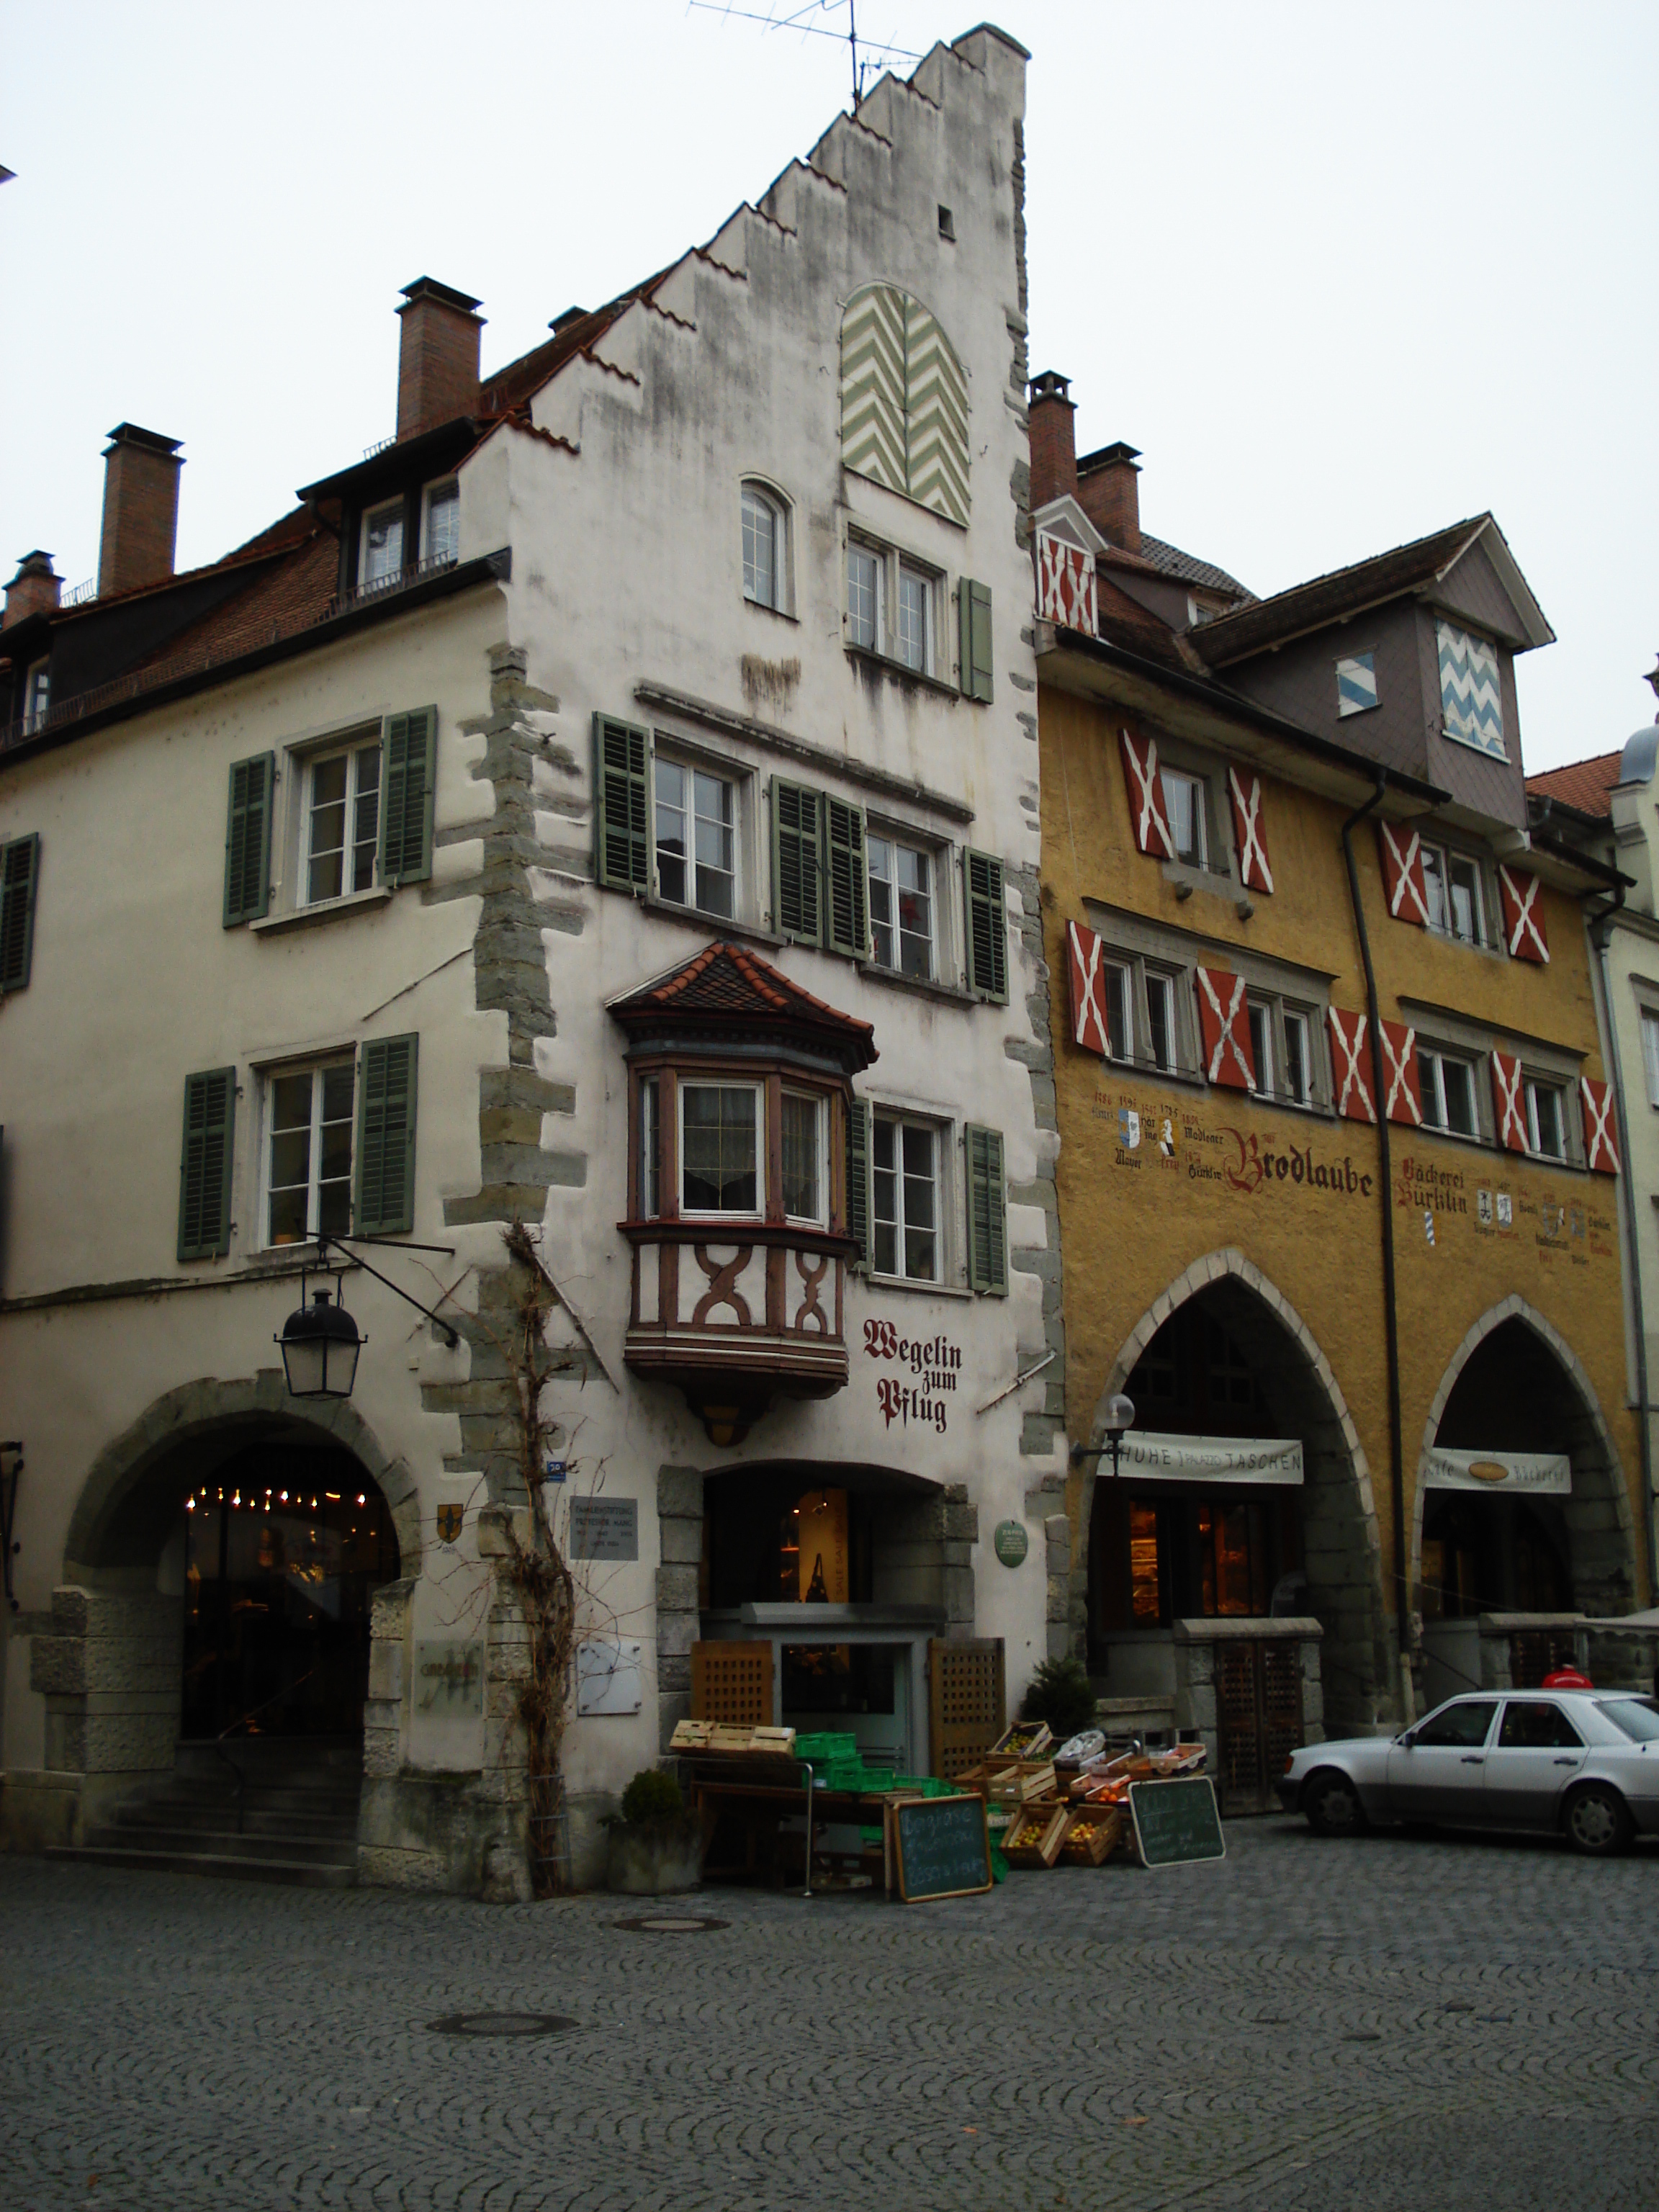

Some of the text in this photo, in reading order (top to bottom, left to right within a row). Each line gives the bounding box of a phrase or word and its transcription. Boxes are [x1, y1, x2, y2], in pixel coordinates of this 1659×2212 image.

[1217, 1127, 1373, 1197] Brodlaube
[863, 1318, 963, 1374] Wegelin
[876, 1377, 948, 1434] Pflug
[922, 1369, 958, 1395] zum
[1225, 1452, 1302, 1472] TASCHEN
